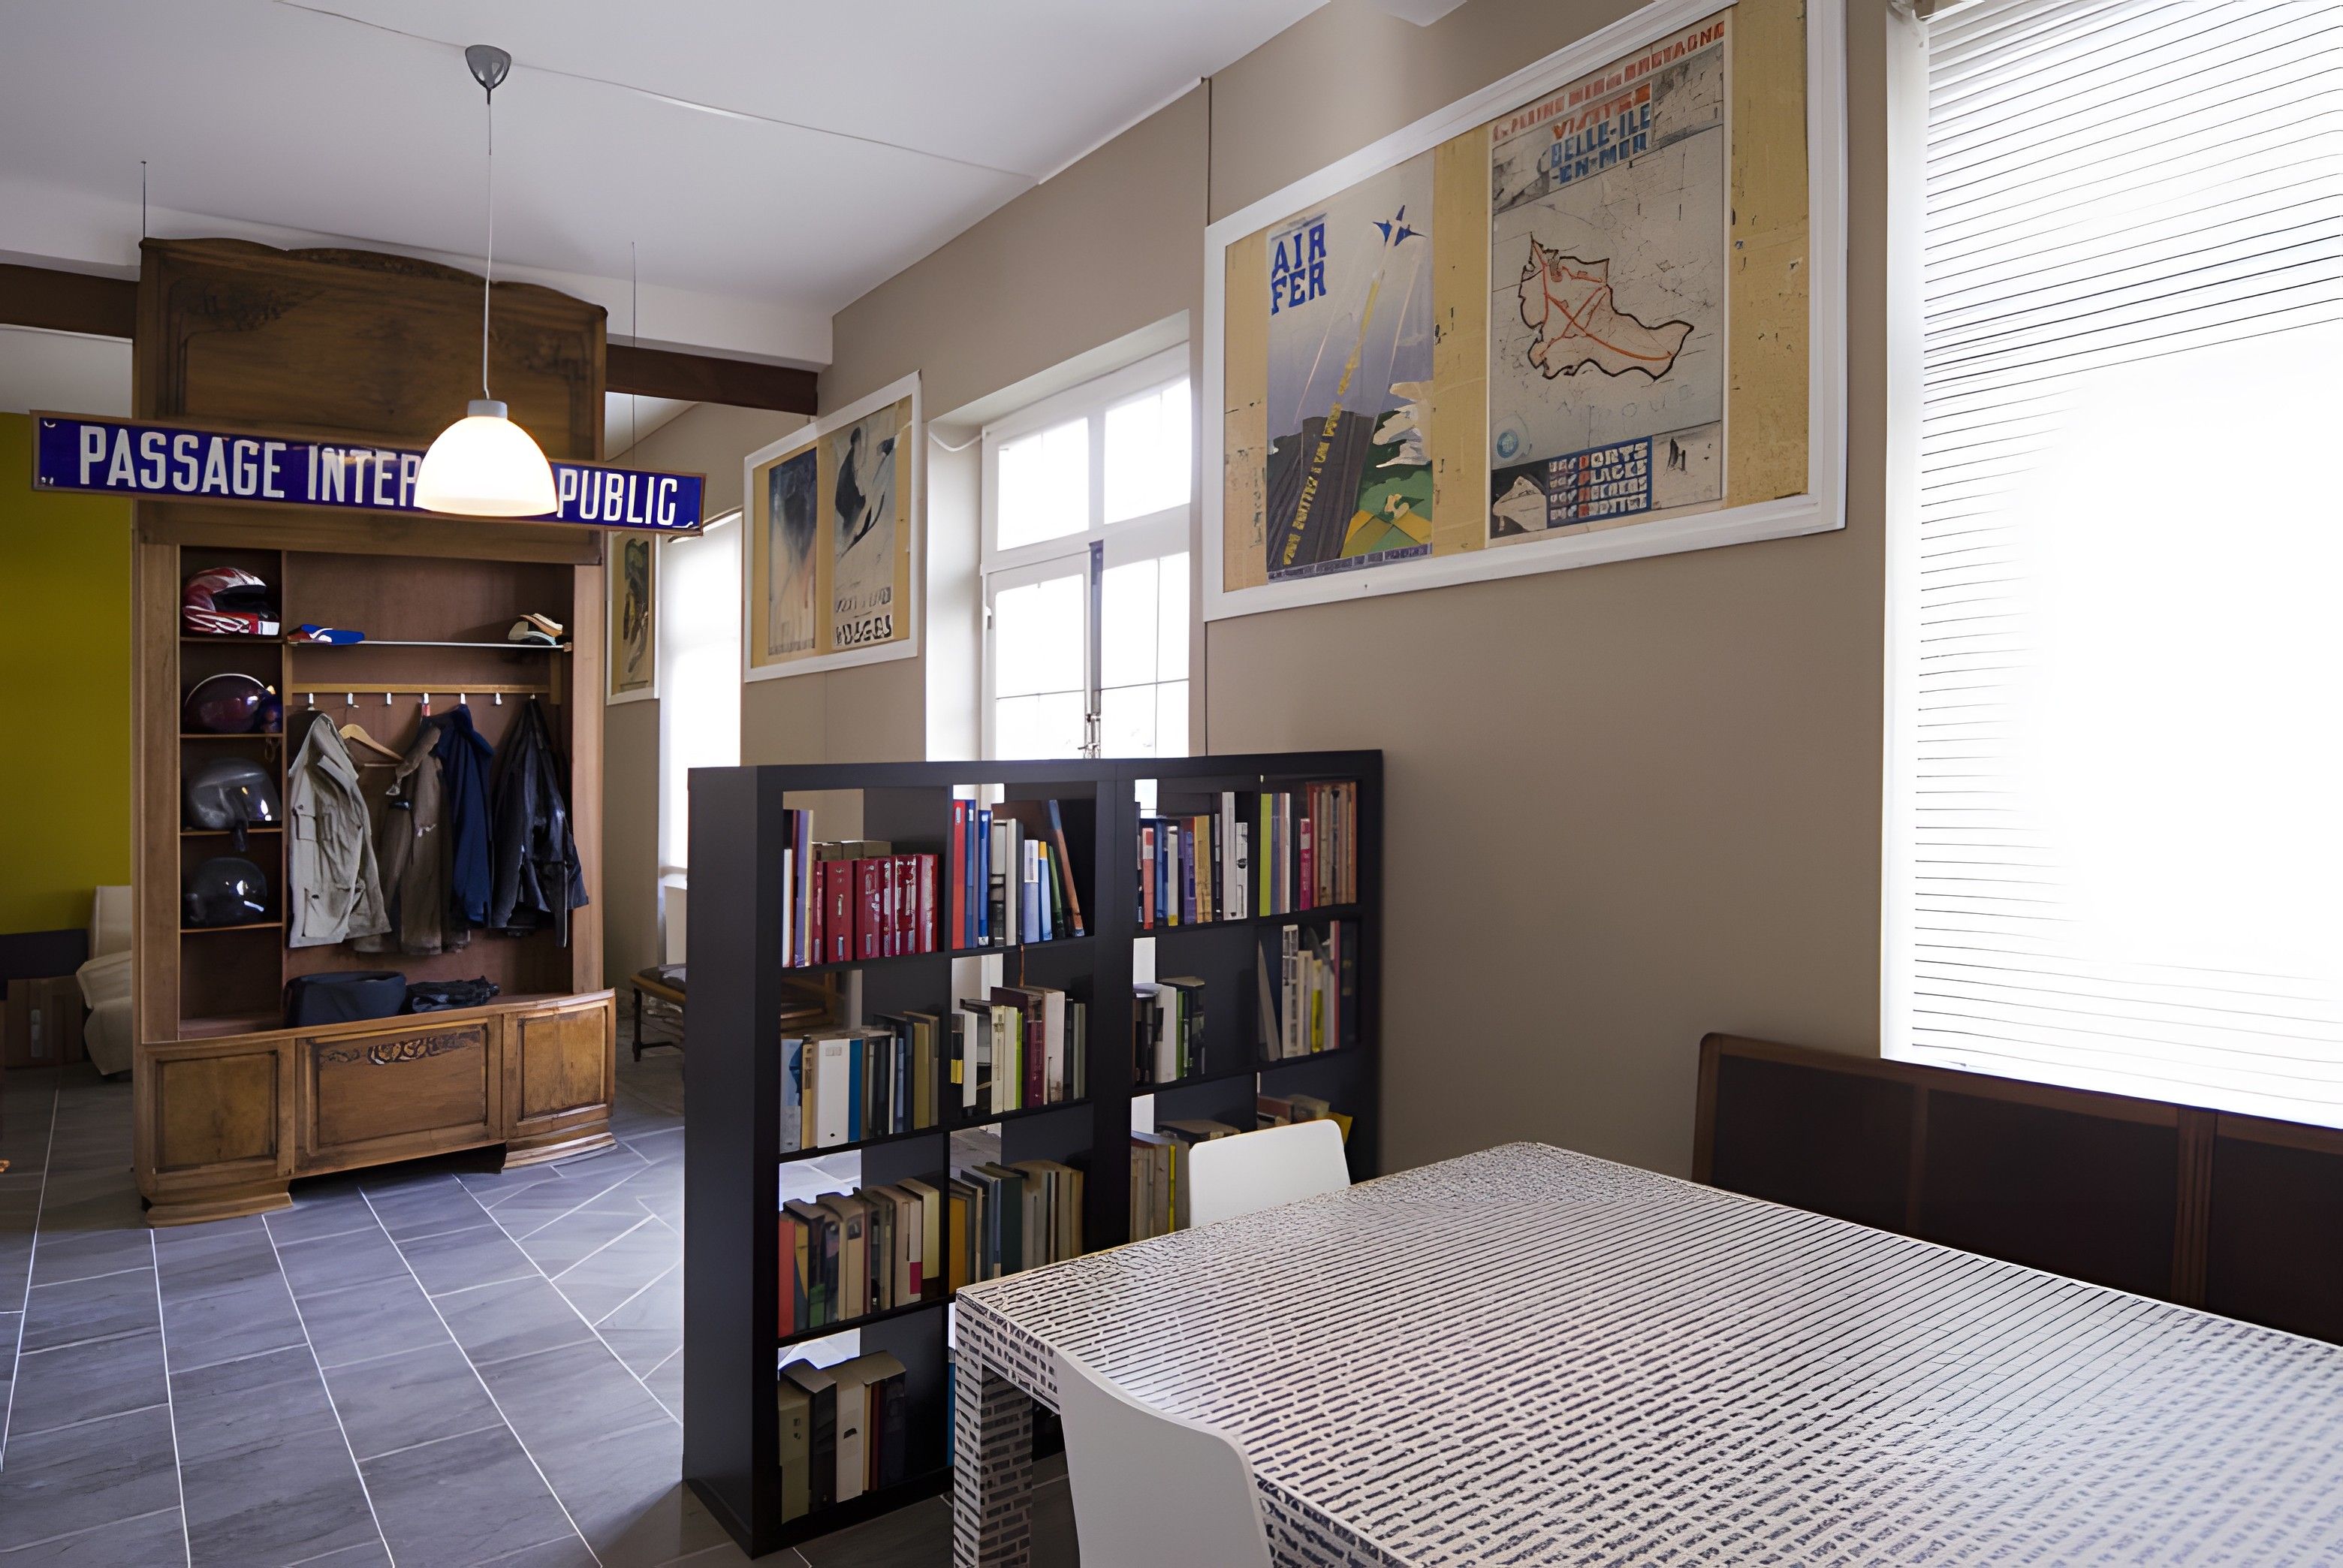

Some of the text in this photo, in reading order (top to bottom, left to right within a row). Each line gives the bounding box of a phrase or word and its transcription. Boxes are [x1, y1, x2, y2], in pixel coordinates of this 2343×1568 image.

[1271, 223, 1326, 279] AIR
[1271, 261, 1326, 315] FER
[80, 425, 677, 526] PASSAGE INTER PUBLIC
